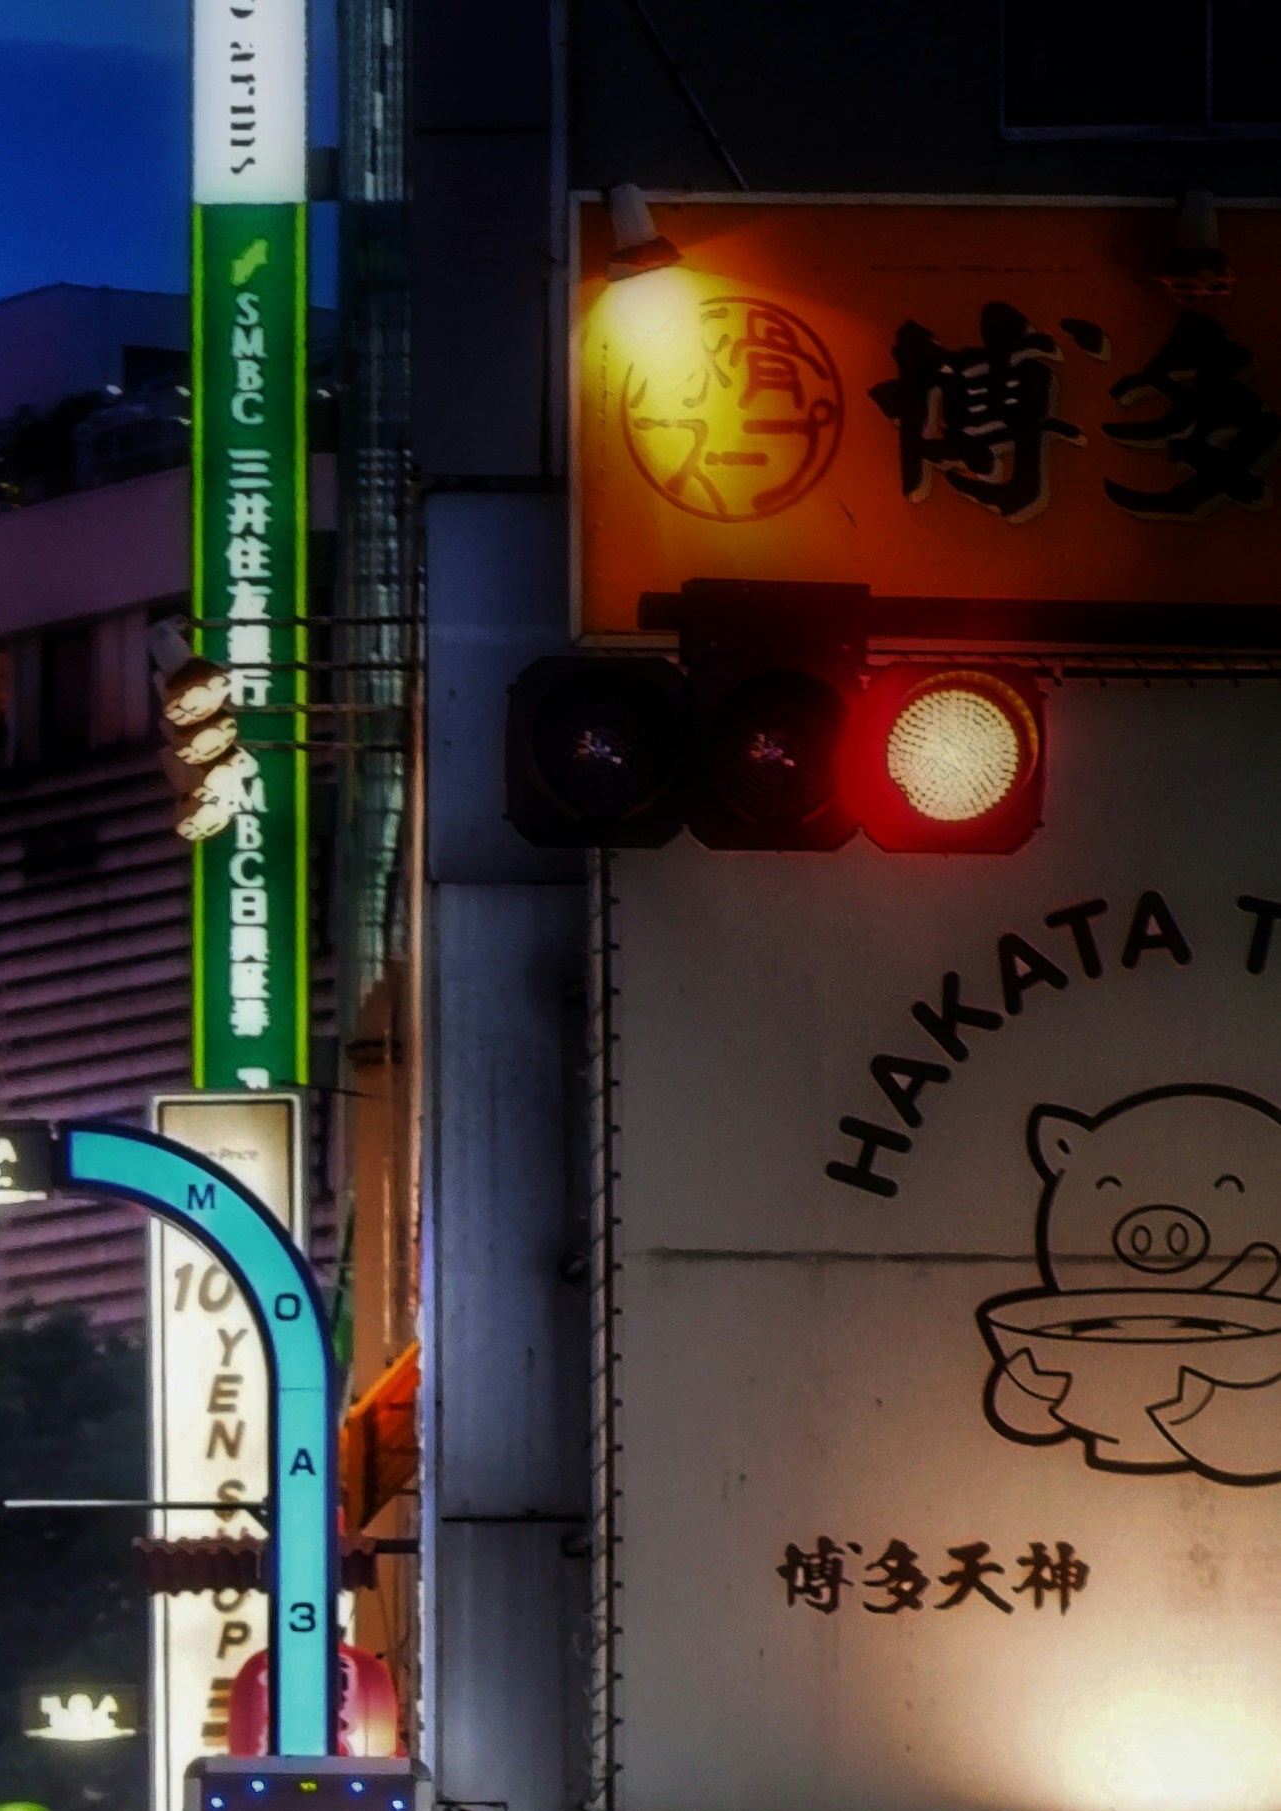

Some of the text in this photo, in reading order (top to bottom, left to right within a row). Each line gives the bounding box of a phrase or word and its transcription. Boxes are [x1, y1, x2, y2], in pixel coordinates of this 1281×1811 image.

[230, 292, 268, 425] SMBC
[824, 888, 1193, 1199] HAKATA
[174, 1263, 235, 1313] 10
[205, 1329, 247, 1459] YEN
[775, 1535, 1090, 1618] 博多天神
